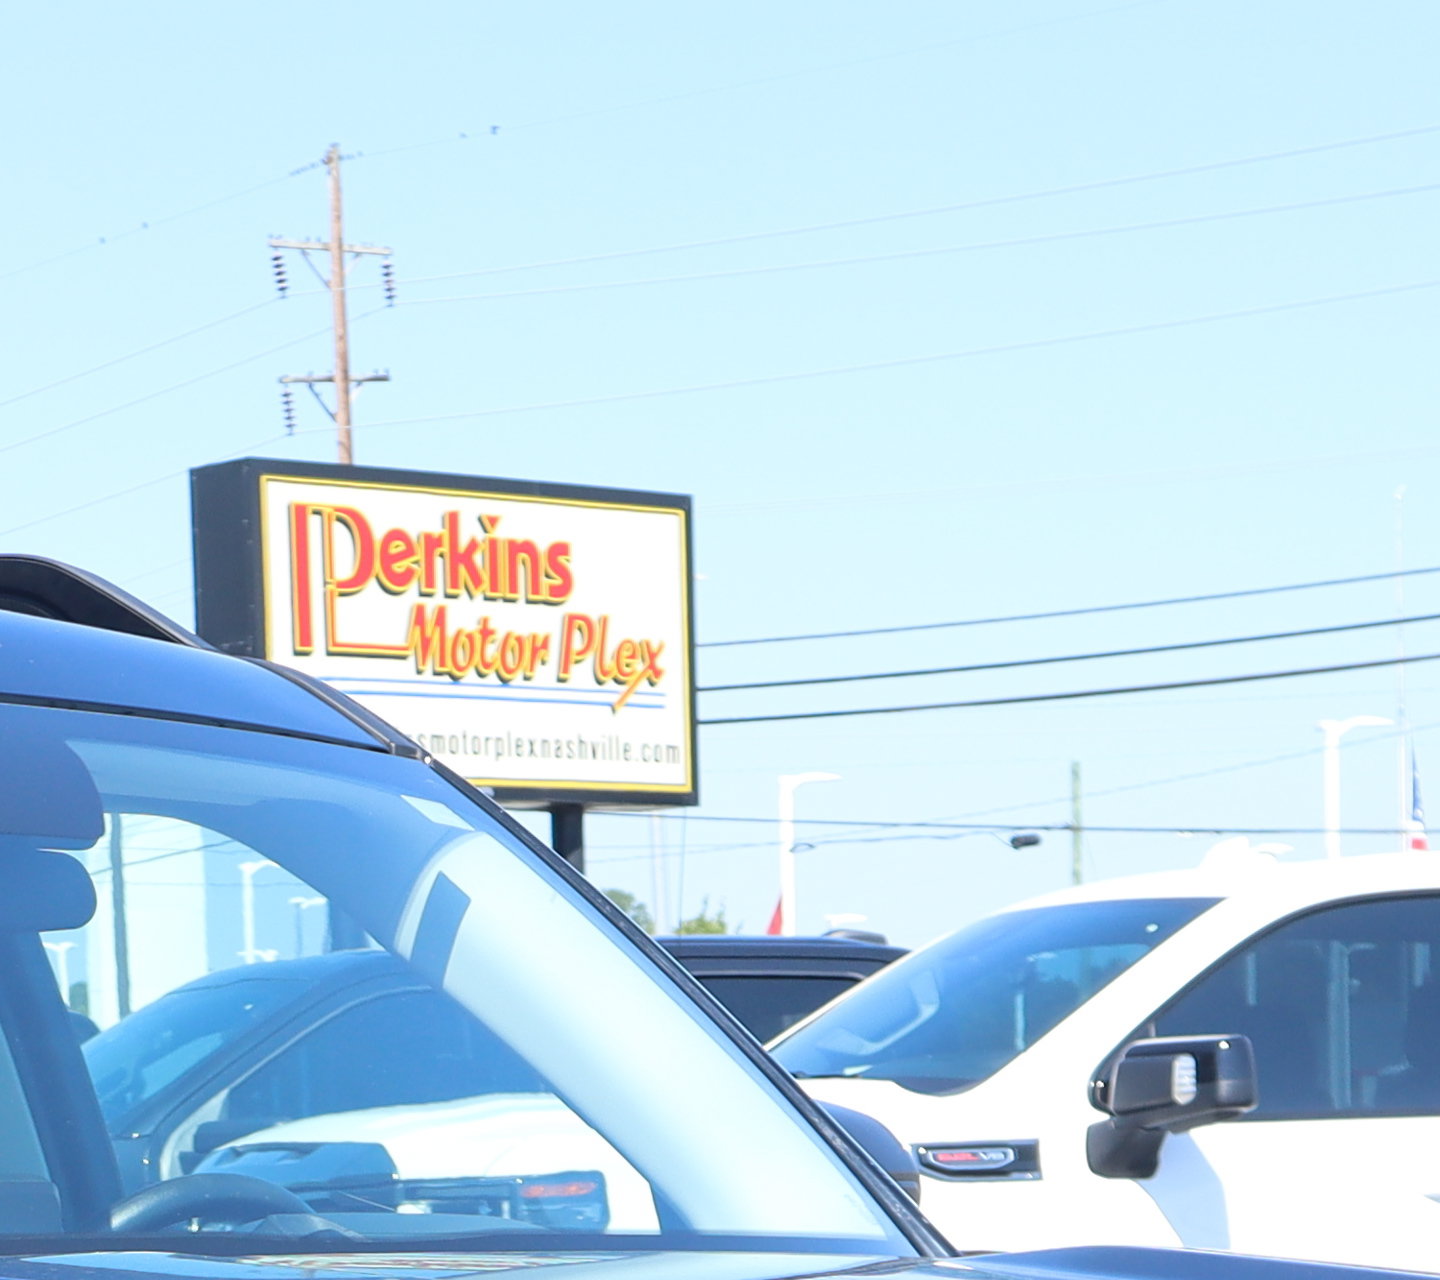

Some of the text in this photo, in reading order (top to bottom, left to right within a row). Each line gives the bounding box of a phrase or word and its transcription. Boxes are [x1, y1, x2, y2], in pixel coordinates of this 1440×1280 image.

[288, 501, 575, 655] Perkins
[409, 602, 665, 713] Motor Plex
